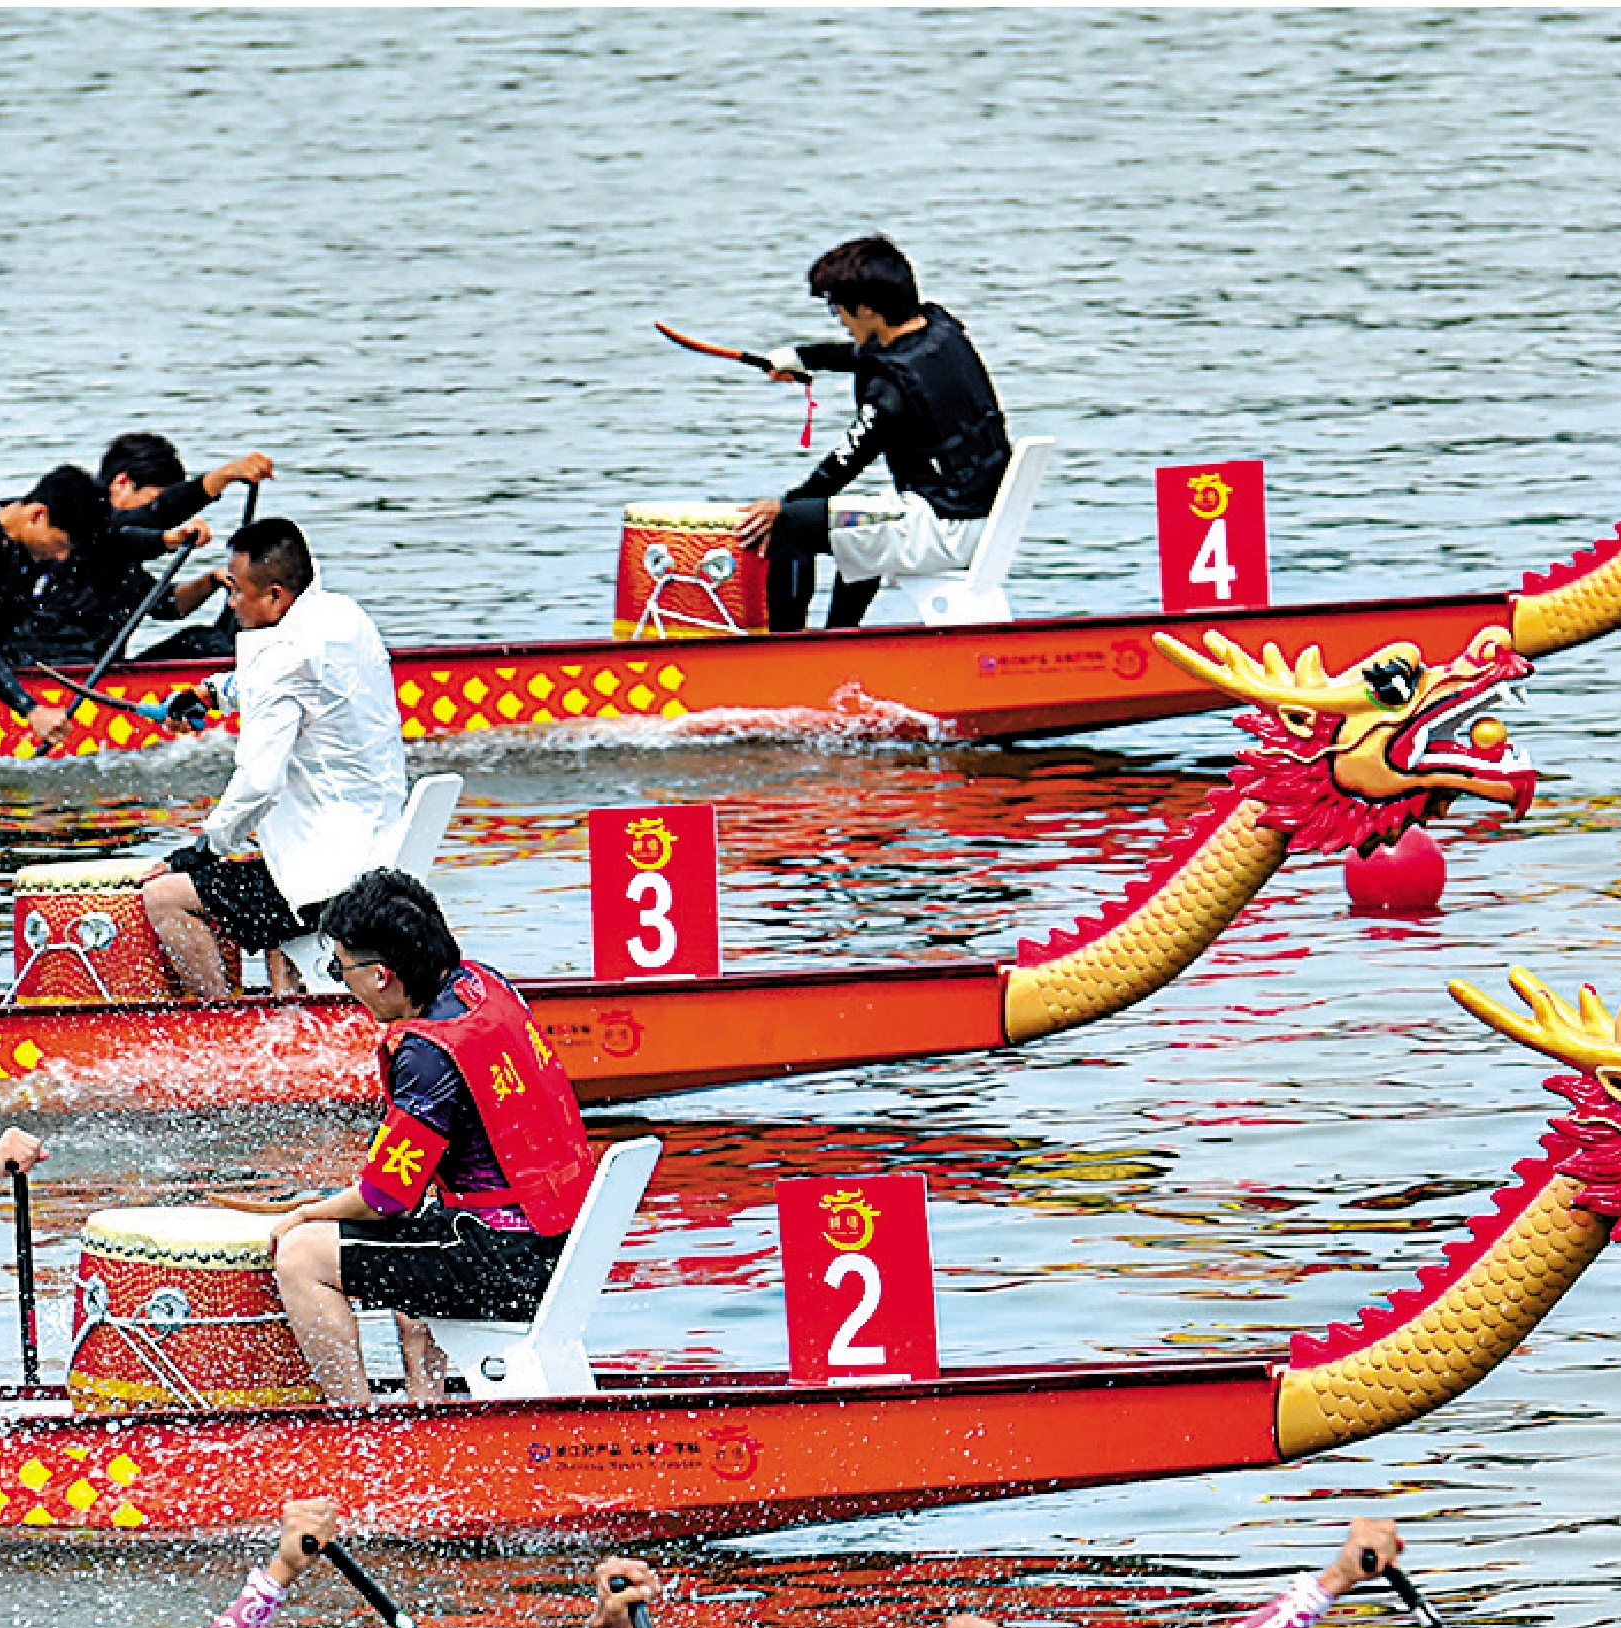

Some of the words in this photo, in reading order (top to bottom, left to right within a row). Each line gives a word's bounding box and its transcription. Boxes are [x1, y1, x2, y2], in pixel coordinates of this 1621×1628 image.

[1189, 518, 1239, 600] 4
[625, 871, 678, 968] 3
[823, 1252, 887, 1366] 2
